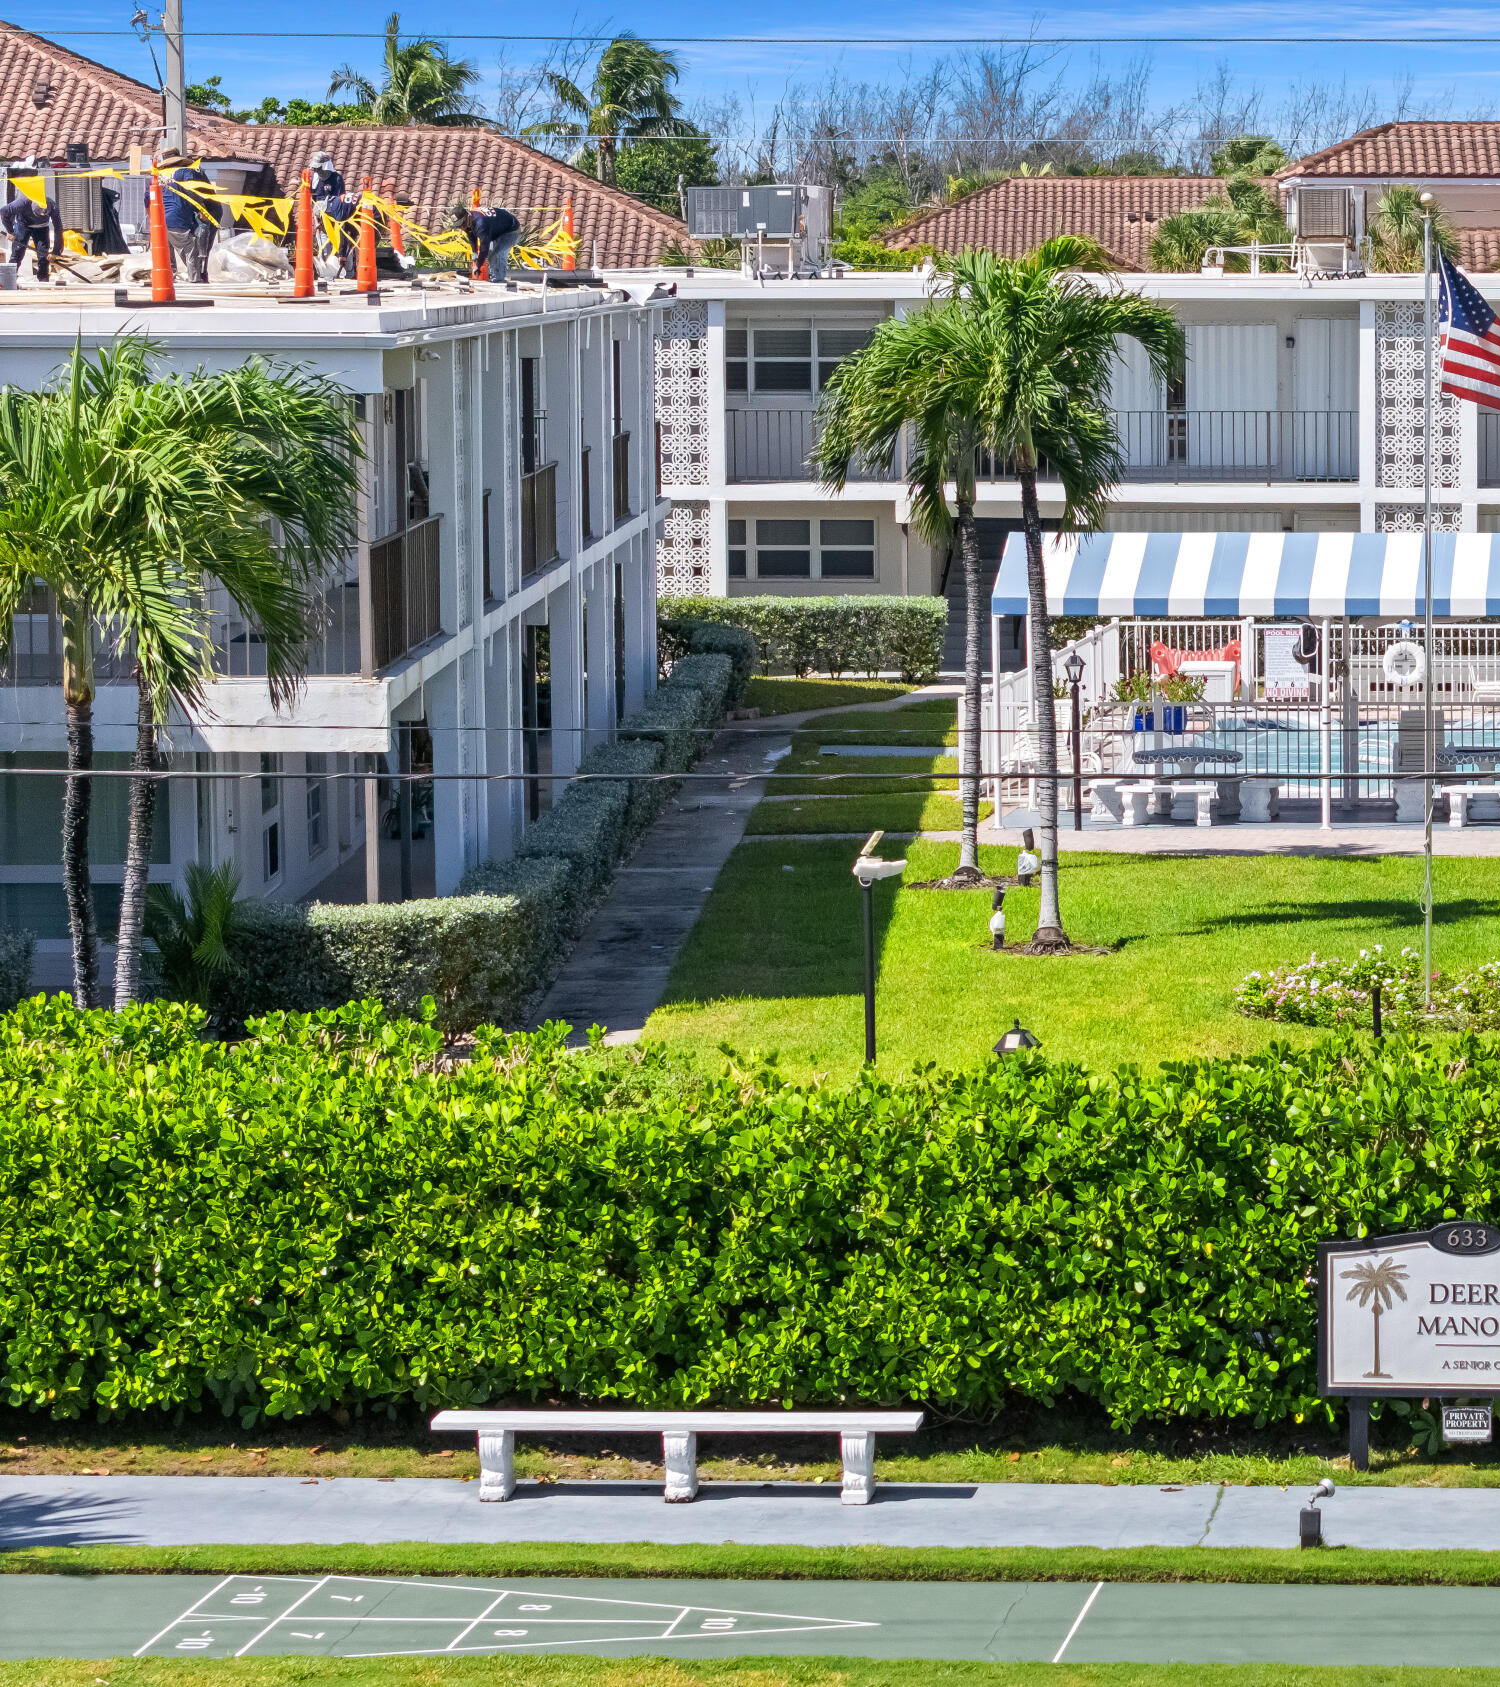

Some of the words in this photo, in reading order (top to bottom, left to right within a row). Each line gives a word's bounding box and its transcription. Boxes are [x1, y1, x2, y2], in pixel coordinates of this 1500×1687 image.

[1266, 688, 1278, 697] NO
[1280, 688, 1308, 697] DIVING
[1447, 1229, 1487, 1247] 633
[1442, 1360, 1451, 1370] A
[1453, 1360, 1492, 1371] SENIOR
[1449, 1412, 1485, 1420] PRIVATE
[1445, 1420, 1489, 1428] PROPERTY
[700, 1616, 738, 1629] 10
